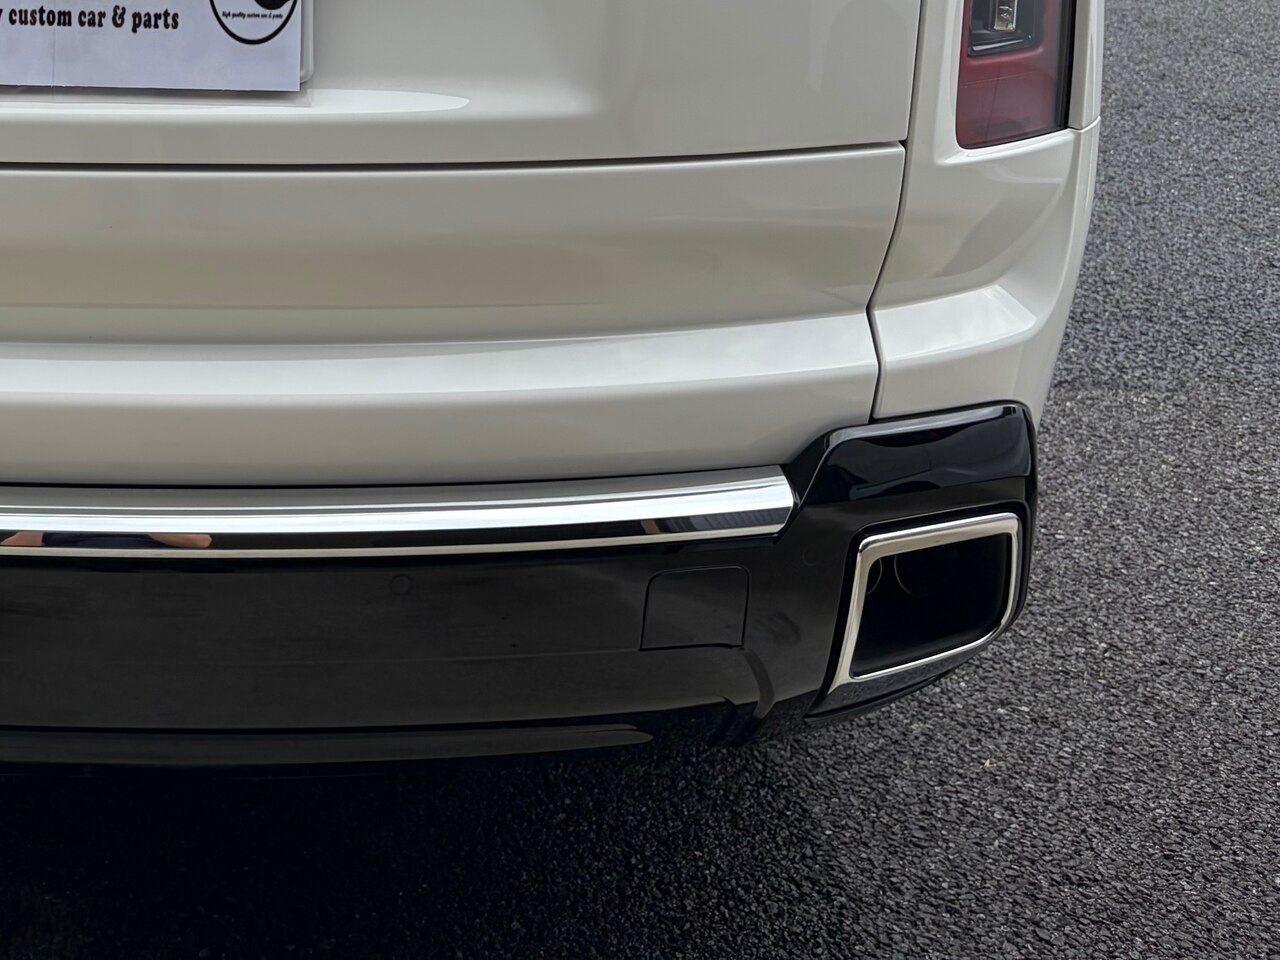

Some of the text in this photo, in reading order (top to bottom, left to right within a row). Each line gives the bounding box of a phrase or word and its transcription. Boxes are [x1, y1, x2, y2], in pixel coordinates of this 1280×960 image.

[9, 6, 72, 27] custom
[78, 10, 106, 28] car
[112, 4, 126, 29] &
[132, 9, 179, 34] parts
